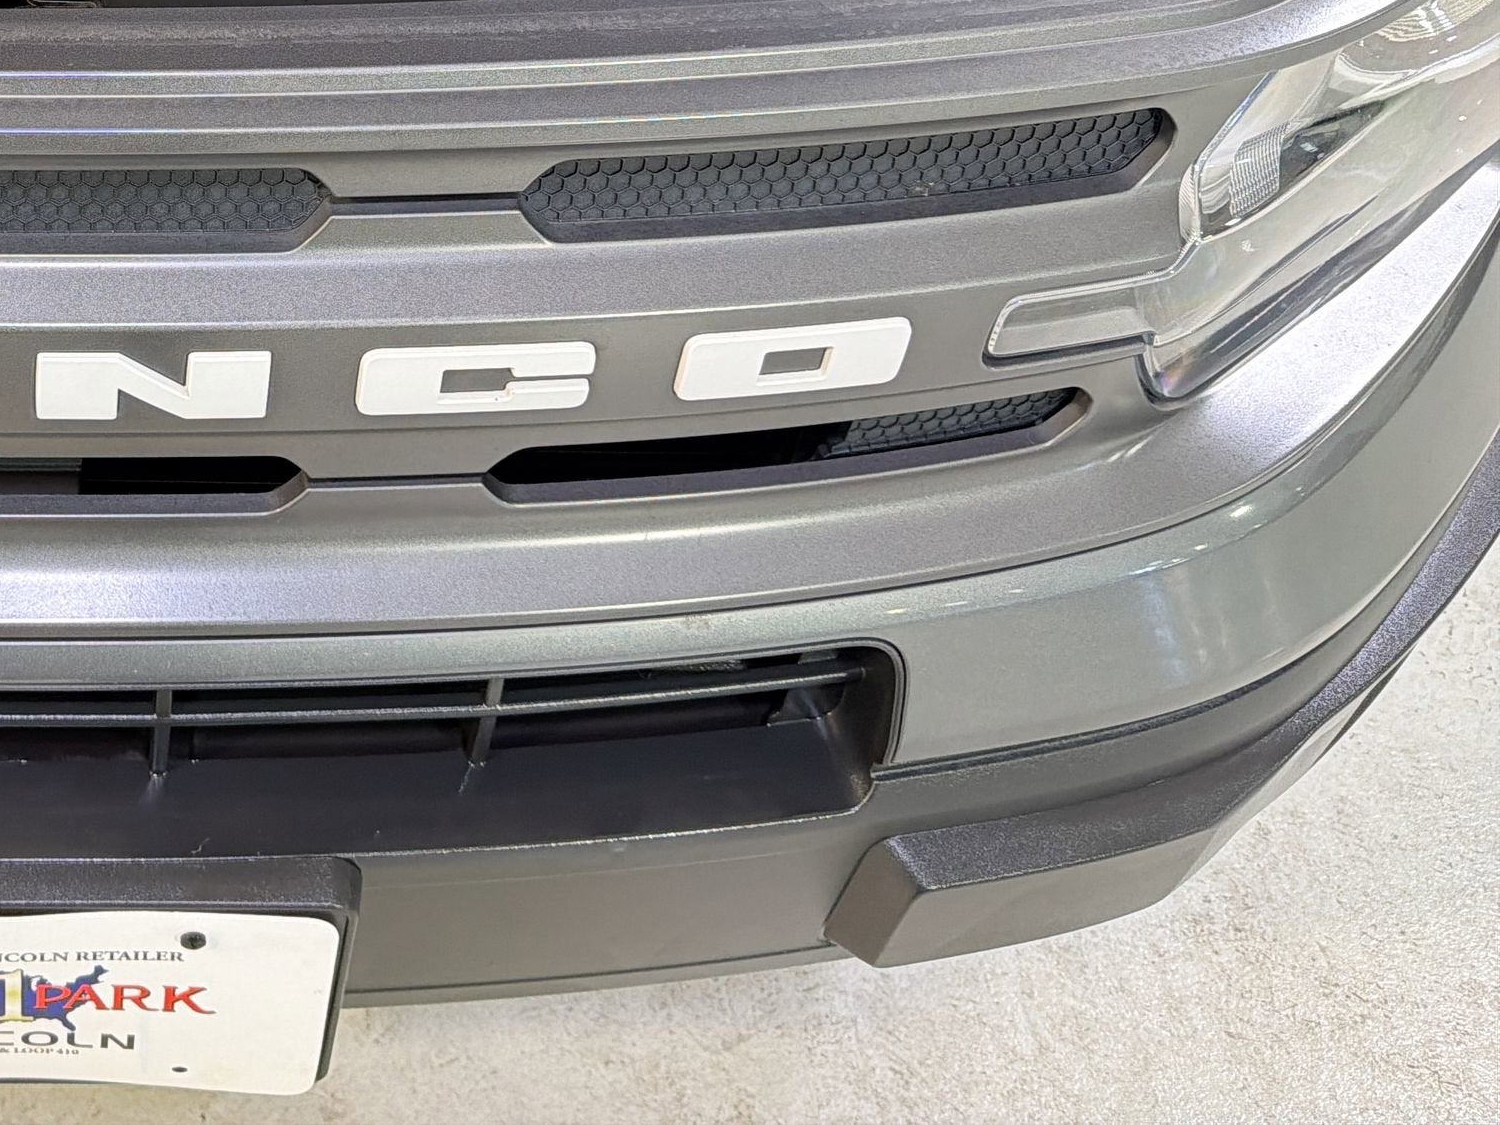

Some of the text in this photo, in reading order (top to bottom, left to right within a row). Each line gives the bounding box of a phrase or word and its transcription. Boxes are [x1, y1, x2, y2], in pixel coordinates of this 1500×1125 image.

[76, 950, 185, 962] RETAILER
[33, 982, 216, 1015] PARK
[0, 1047, 11, 1055] &
[14, 1047, 54, 1055] LOOP
